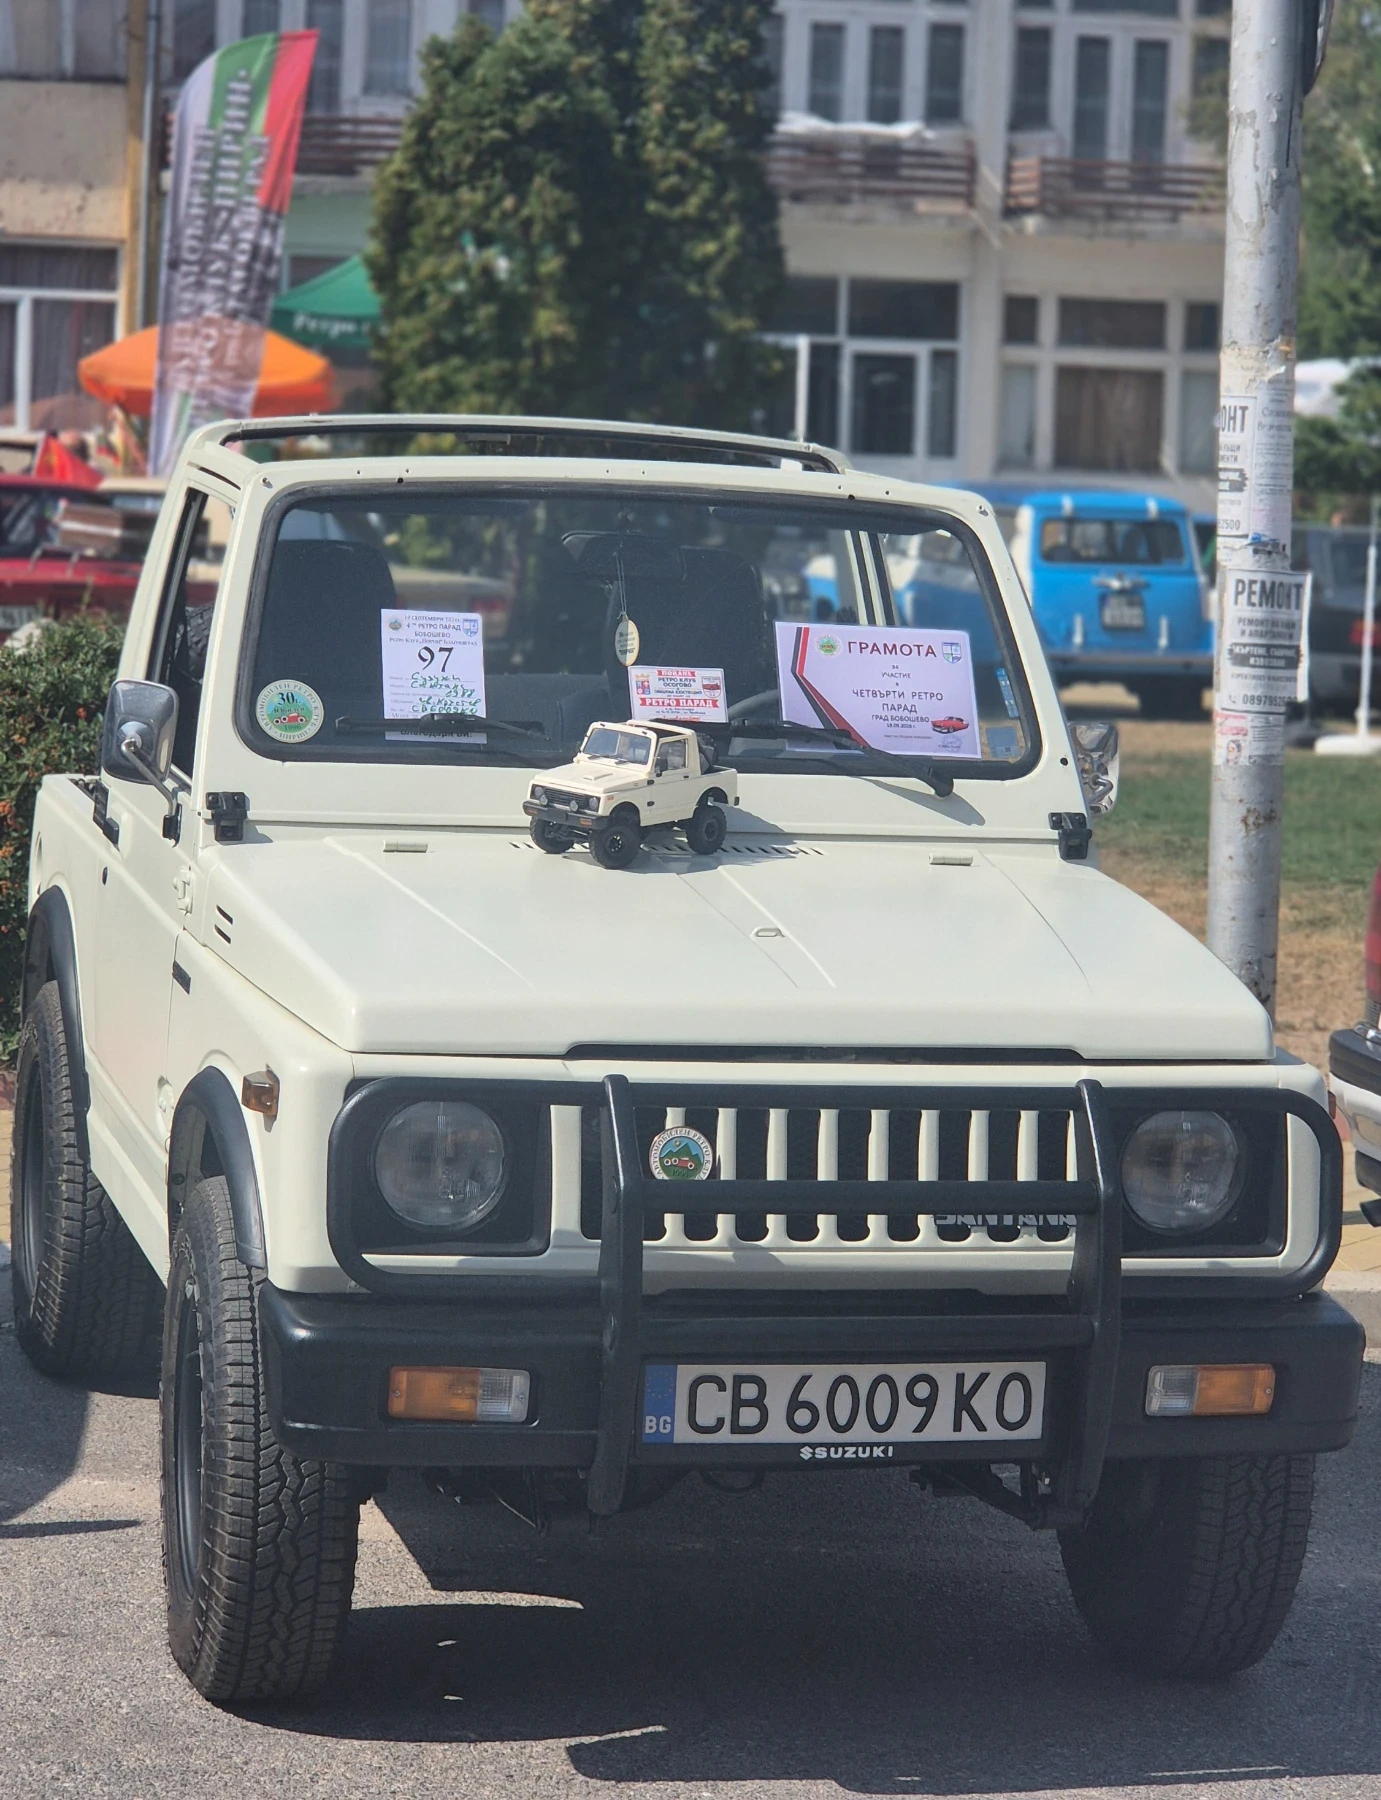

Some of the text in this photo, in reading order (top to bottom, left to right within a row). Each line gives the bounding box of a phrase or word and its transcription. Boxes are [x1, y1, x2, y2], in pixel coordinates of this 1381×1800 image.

[1233, 578, 1303, 611] РЕМОНТ
[439, 623, 462, 631] ПАРАД
[848, 641, 937, 658] ГРАМОТА
[417, 645, 454, 673] 97
[277, 691, 295, 706] 30
[852, 688, 944, 701] ЧЕТВЪРТИ РЕТРО
[645, 698, 713, 708] РЕТРО ПАРАД
[881, 703, 918, 714] ПАРАД
[871, 714, 930, 723] ГРАД БОБОШЕВО
[652, 1128, 690, 1175] АВТОМОБИЛЕН
[692, 1133, 710, 1156] РЕТРО
[645, 1371, 1032, 1435] BG CB 6009 KO
[814, 1445, 894, 1459] SUZUKI
